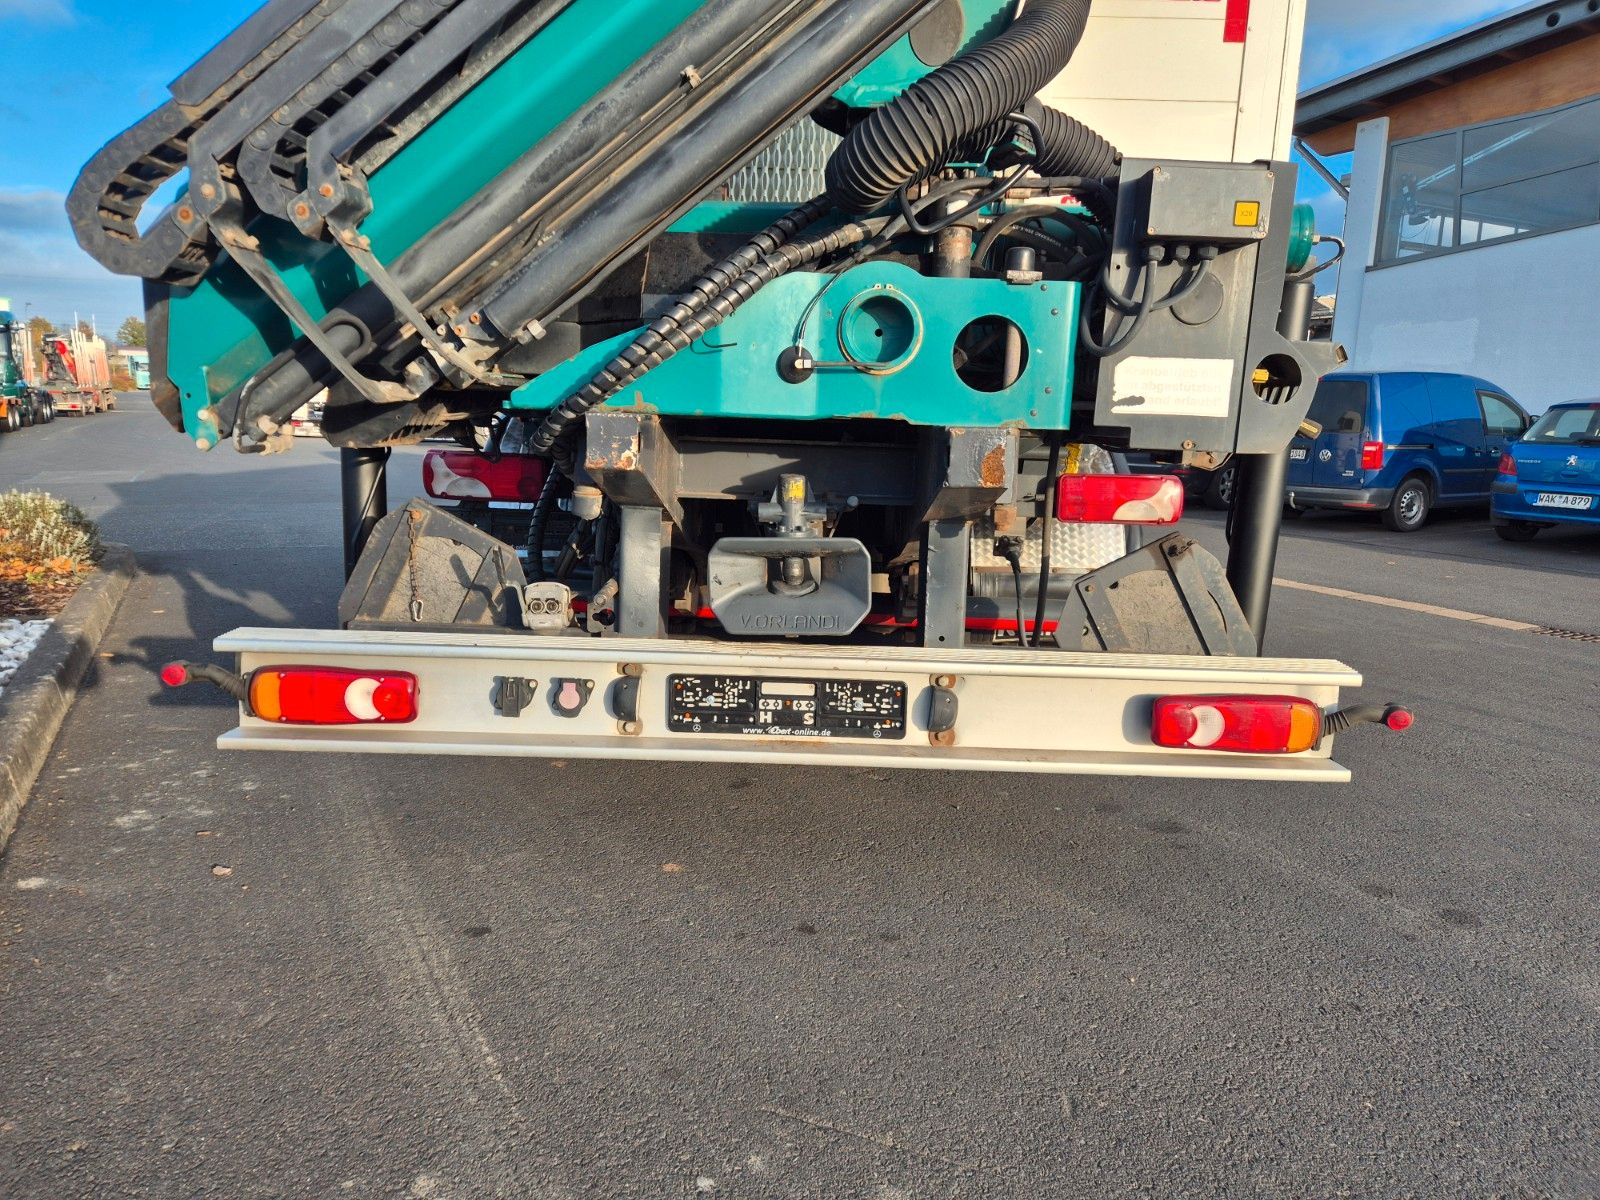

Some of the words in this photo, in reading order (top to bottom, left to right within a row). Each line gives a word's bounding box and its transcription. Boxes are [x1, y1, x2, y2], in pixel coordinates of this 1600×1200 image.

[1538, 494, 1557, 504] WAK
[740, 614, 841, 630] V.ORLANDI
[759, 711, 772, 724] H
[803, 712, 815, 725] S
